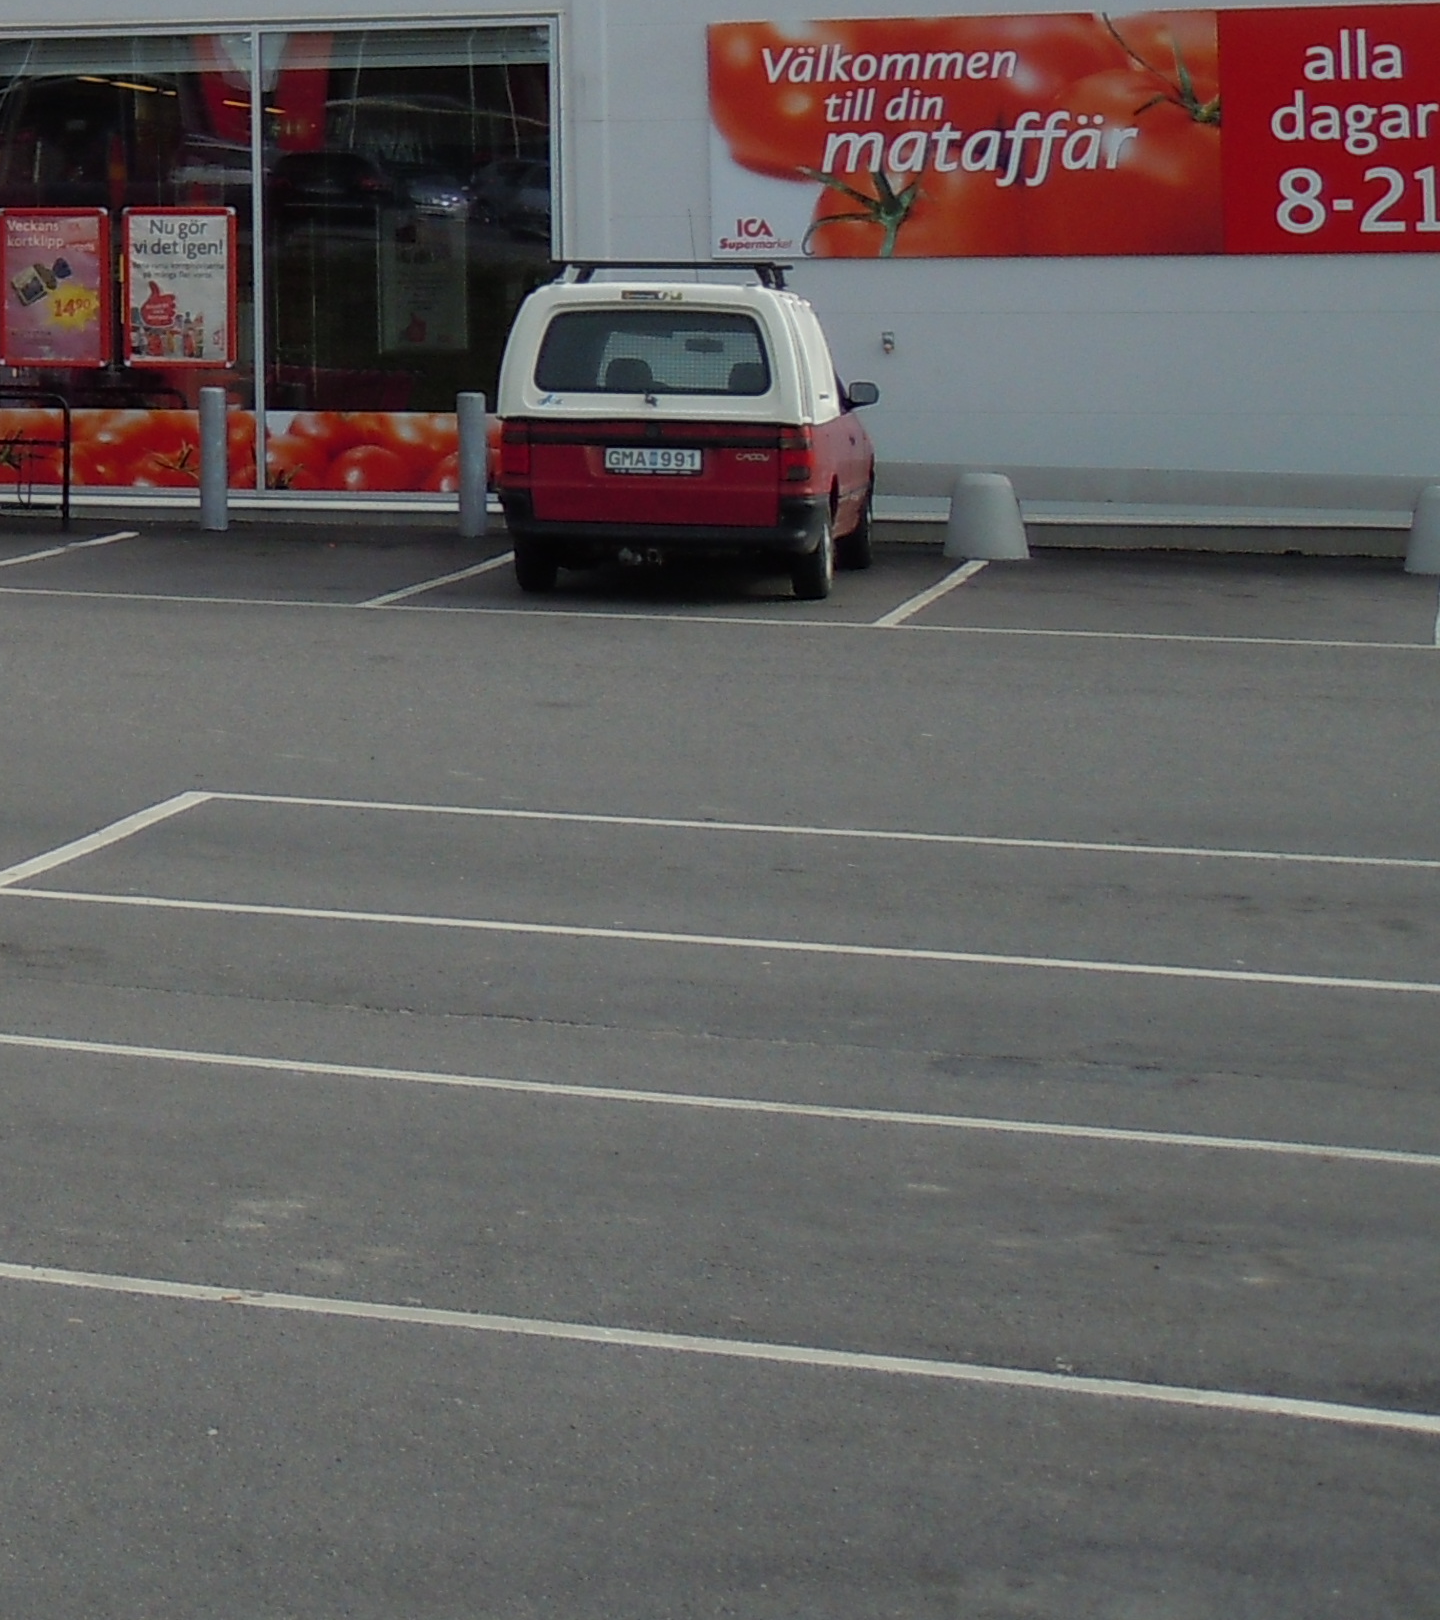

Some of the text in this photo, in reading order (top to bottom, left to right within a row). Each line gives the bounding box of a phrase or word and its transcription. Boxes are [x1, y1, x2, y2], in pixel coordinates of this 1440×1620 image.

[761, 44, 1018, 84] Välkommen
[1303, 28, 1404, 81] alla
[823, 87, 945, 123] till din
[1271, 89, 1440, 155] dagar
[821, 110, 1139, 188] mataffär
[1276, 165, 1440, 234] 8-21
[6, 219, 60, 232] Veckans
[149, 219, 208, 240] Nu gör
[736, 218, 774, 238] ICA
[6, 235, 64, 250] kortklipp
[133, 239, 223, 260] vi det igen!
[718, 237, 793, 251] Supermarket
[608, 451, 696, 468] GMA 991
